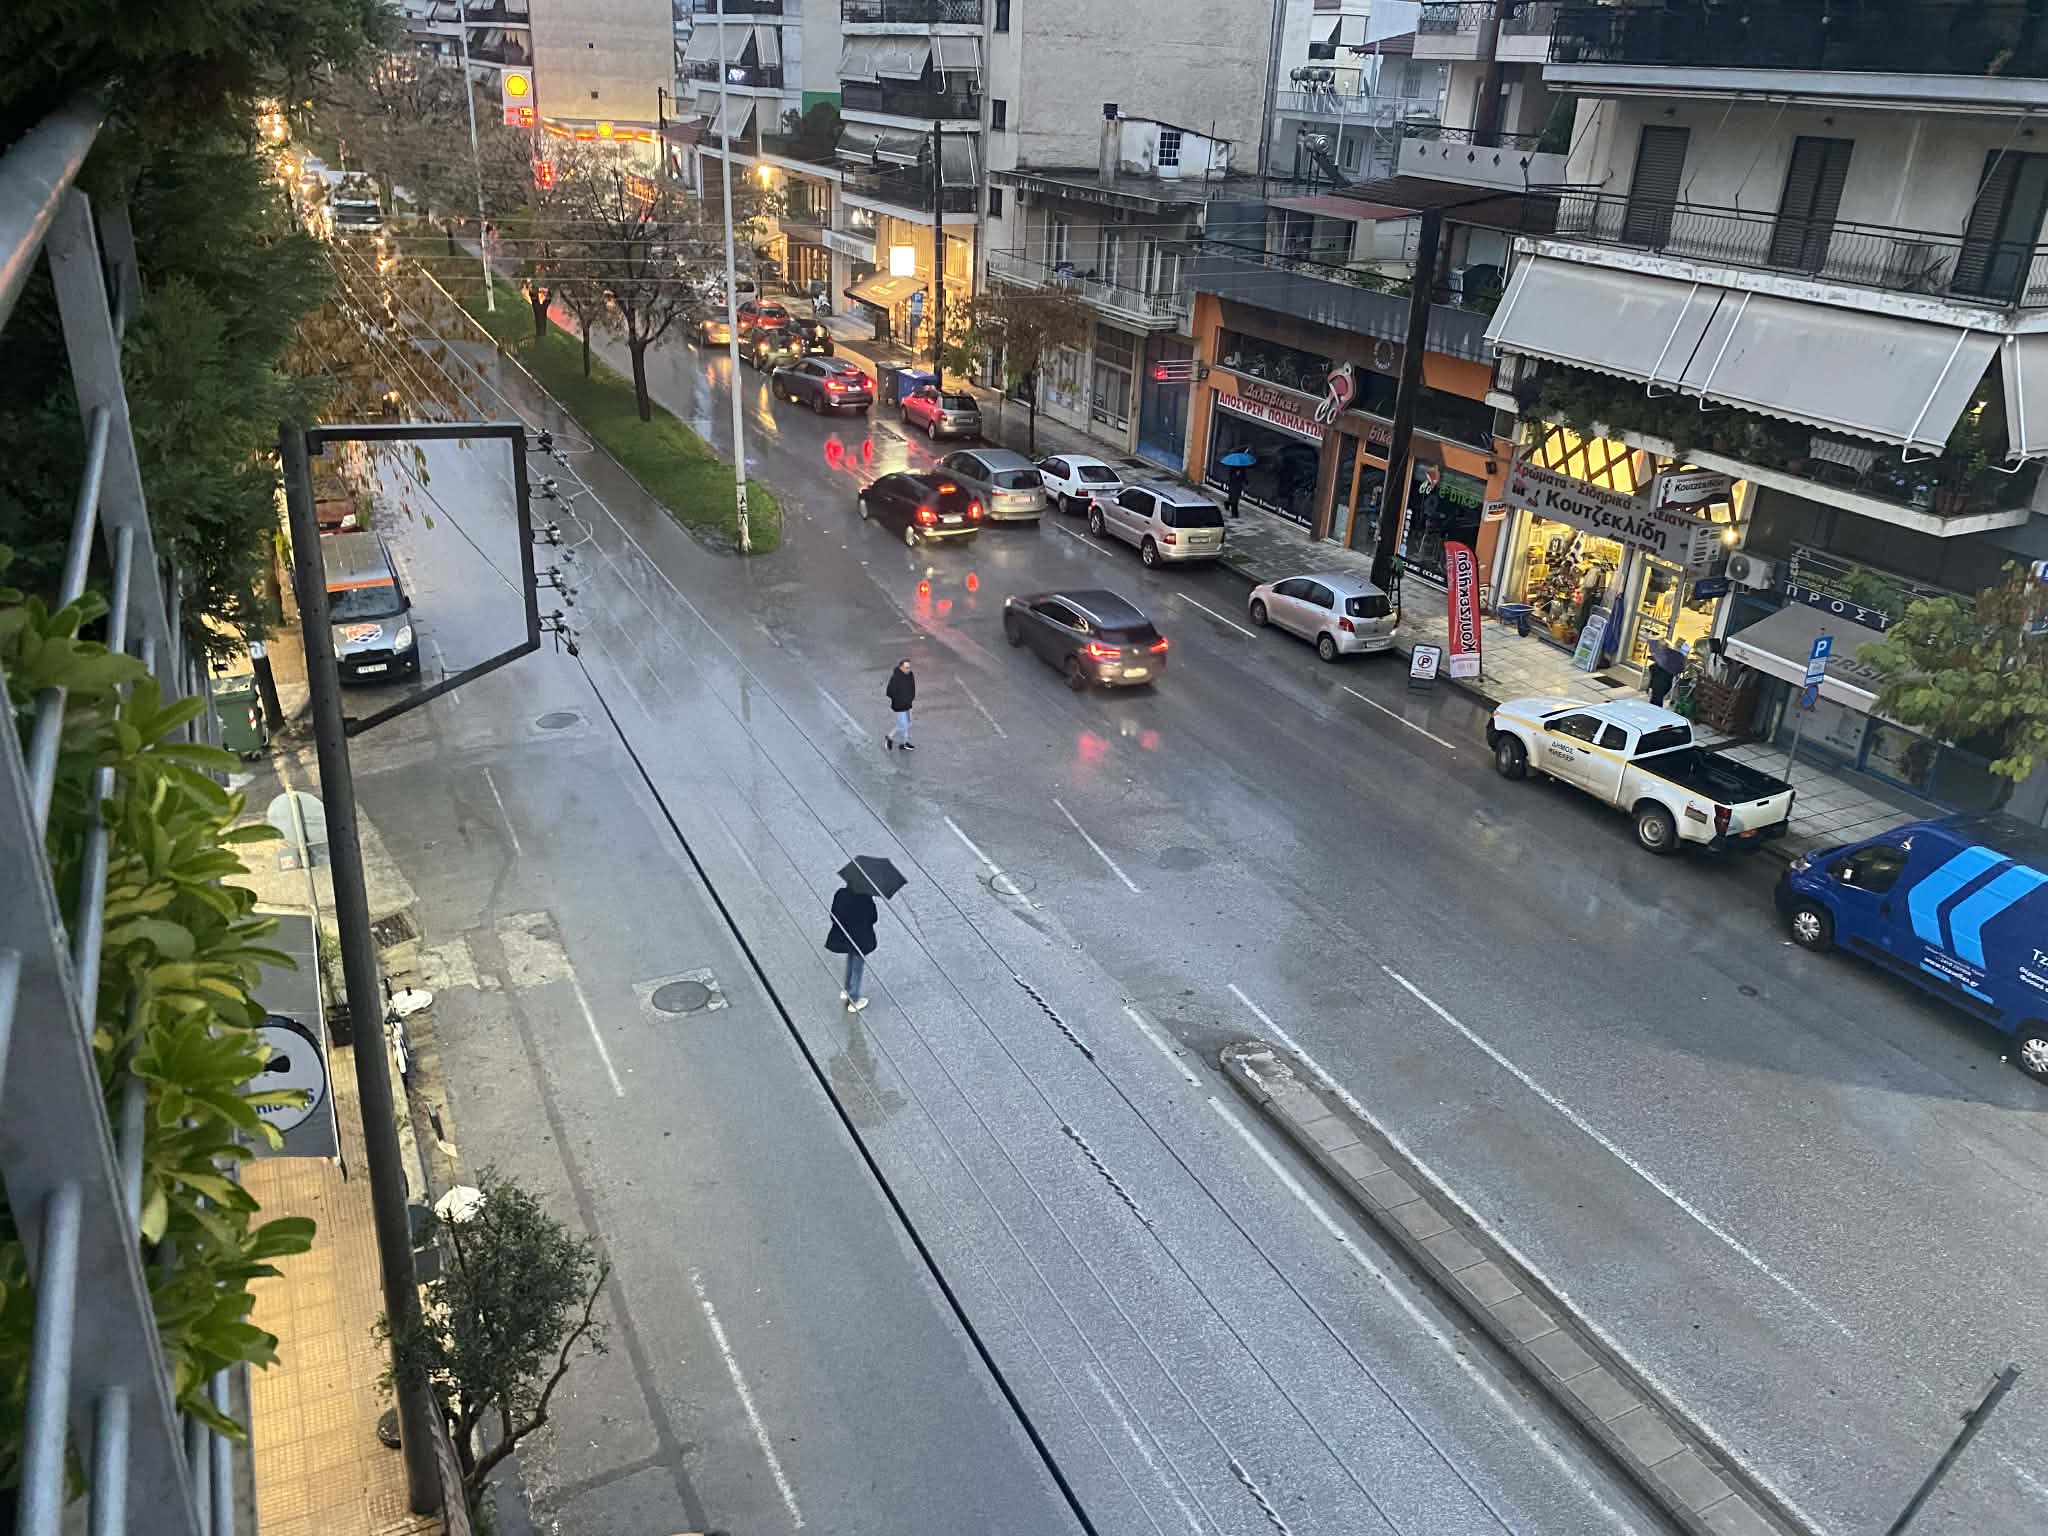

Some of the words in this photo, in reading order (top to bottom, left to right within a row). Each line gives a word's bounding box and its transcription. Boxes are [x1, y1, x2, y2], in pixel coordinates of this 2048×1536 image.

[1220, 391, 1264, 417] ΑΠΟΣΥΡΣΗ
[1515, 461, 1567, 490] Χρώματα
[1577, 484, 1633, 511] Σιδηρικά
[1546, 489, 1667, 551] Κουτζεκλίδη
[1815, 640, 1827, 657] P
